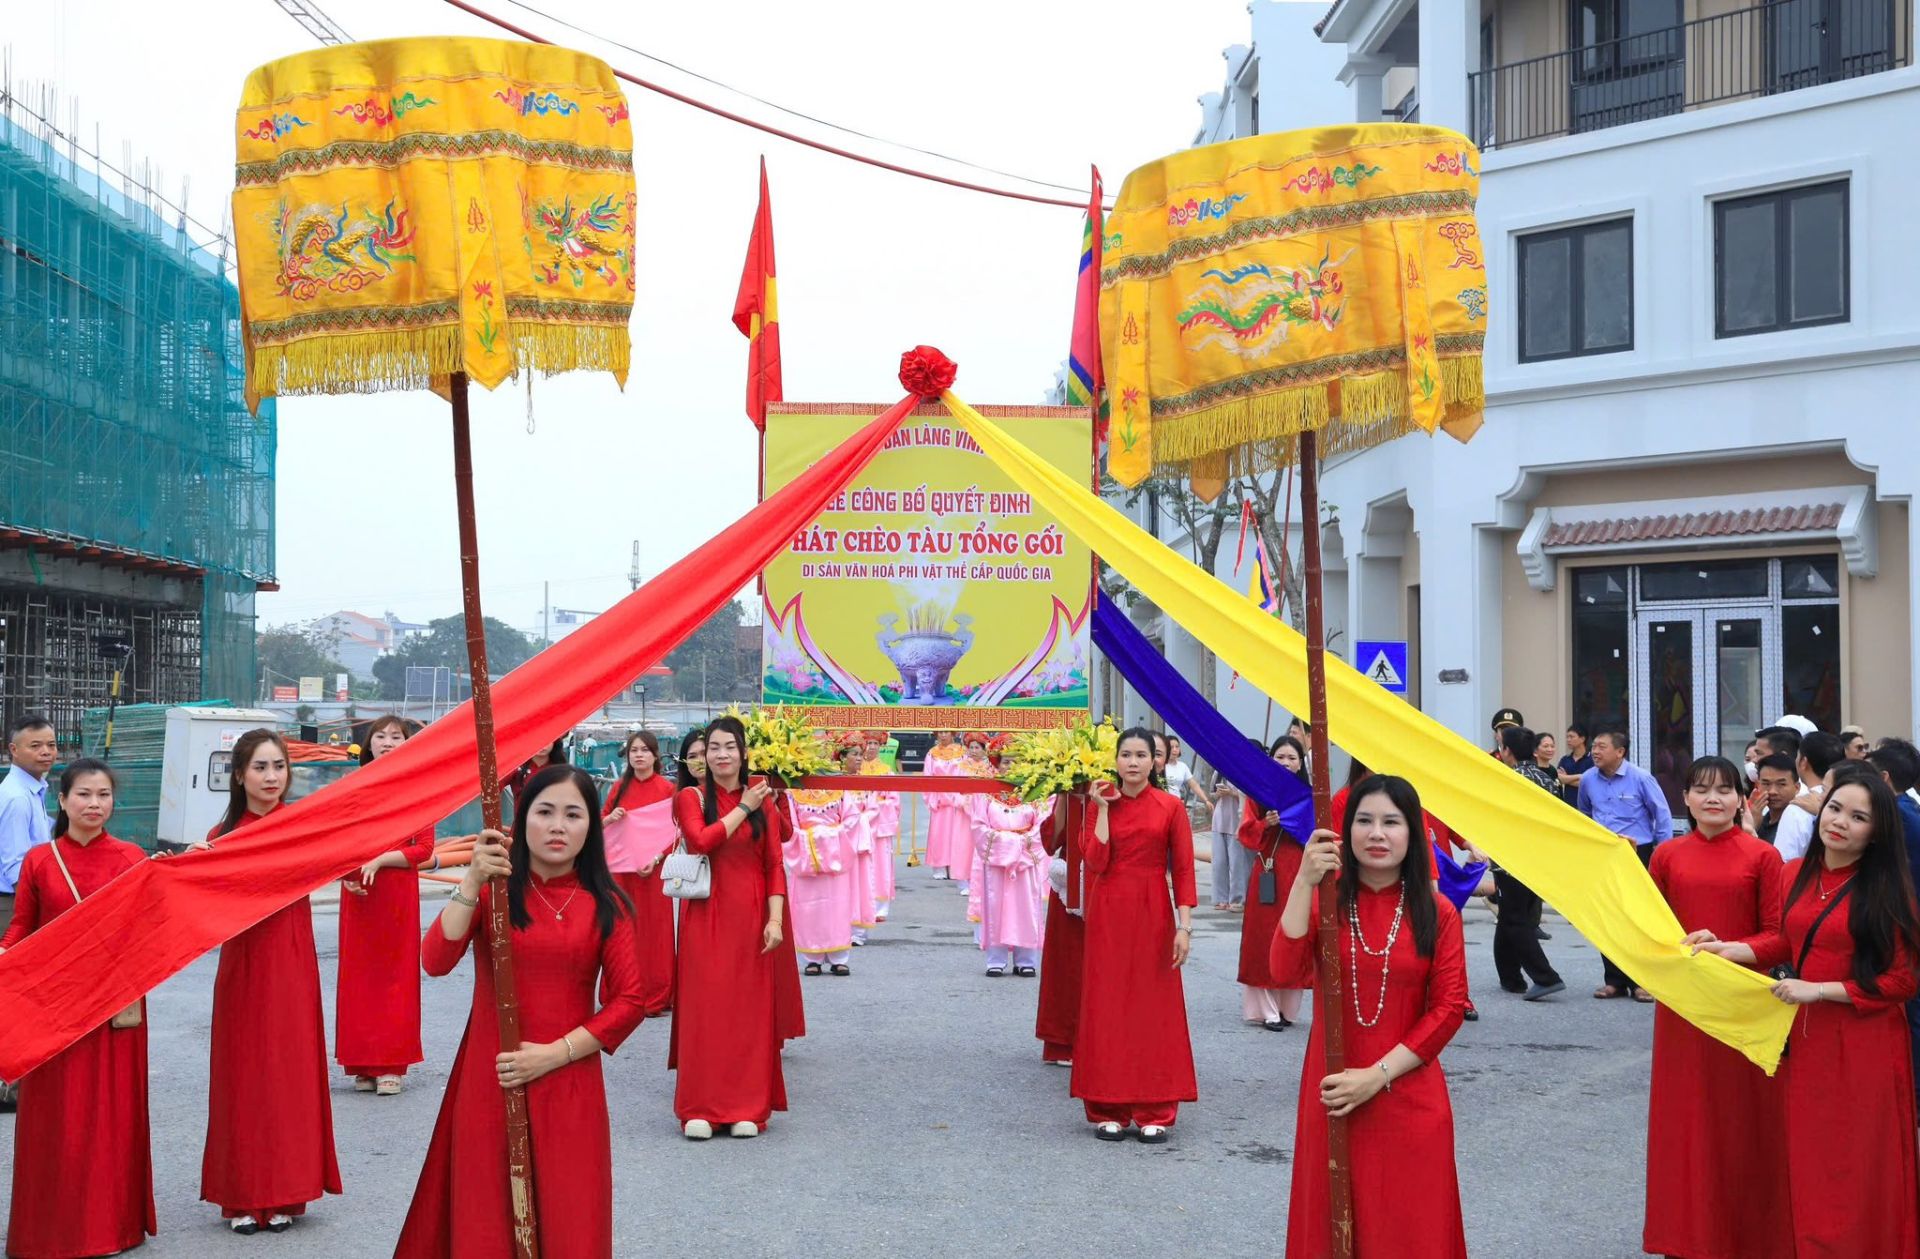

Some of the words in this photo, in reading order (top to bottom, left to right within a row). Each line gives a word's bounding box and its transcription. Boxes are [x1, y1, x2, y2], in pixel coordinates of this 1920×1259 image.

[915, 424, 951, 446] LÀNG
[852, 487, 896, 512] CÔNG
[903, 485, 926, 512] BỐ
[931, 485, 985, 516] QUYẾT
[990, 493, 1031, 517] ĐỊNH
[792, 525, 838, 552] HÁT
[844, 525, 902, 552] CHÈO
[907, 526, 953, 553] TÀU
[959, 521, 1018, 554] TỔNG
[1025, 524, 1063, 554] GỐI
[803, 564, 814, 577] DI
[818, 561, 841, 577] SẢN
[845, 562, 868, 577] VĂN
[872, 563, 895, 578] HOÁ
[899, 565, 918, 578] PHI
[922, 563, 943, 581] VẬT
[946, 561, 967, 579] THỂ
[971, 562, 993, 579] CẤP
[997, 563, 1028, 580] QUỐC
[1032, 567, 1051, 580] GIA
